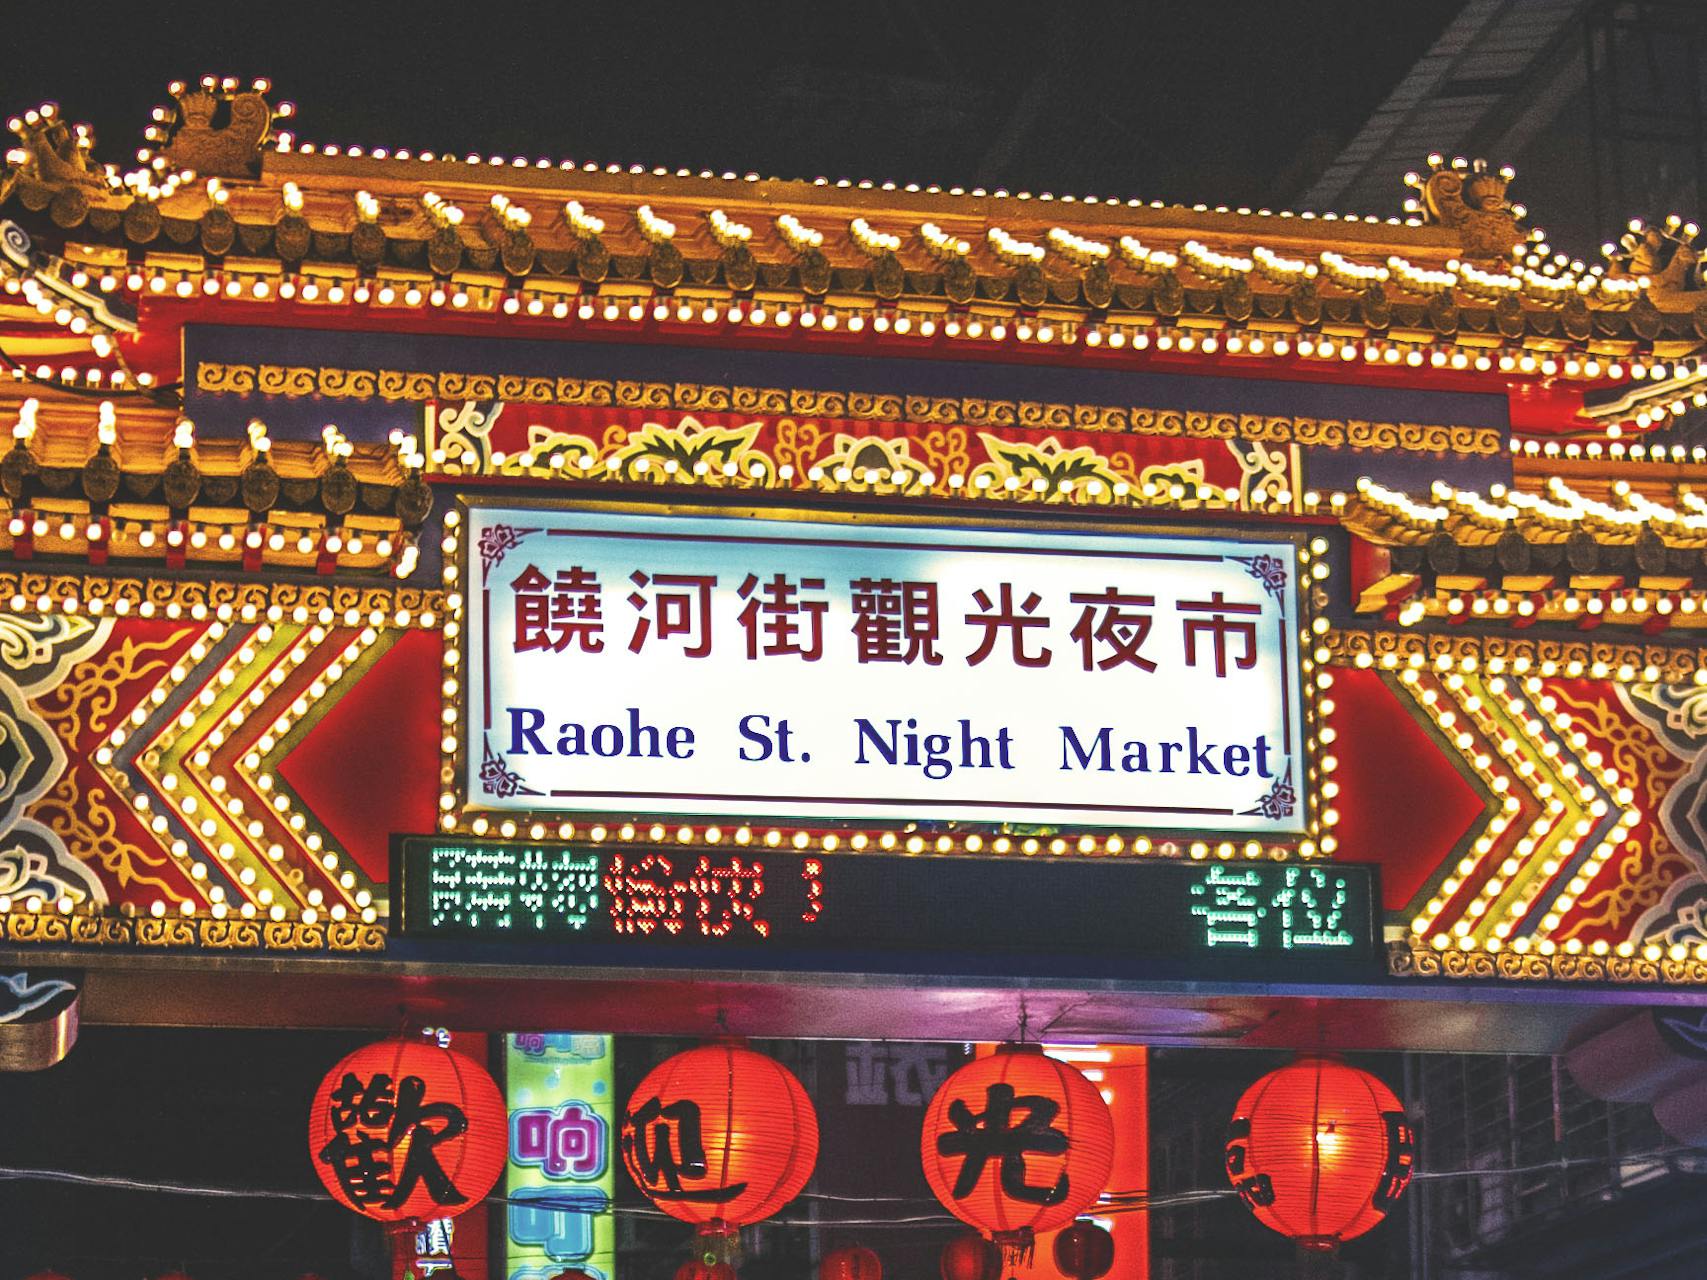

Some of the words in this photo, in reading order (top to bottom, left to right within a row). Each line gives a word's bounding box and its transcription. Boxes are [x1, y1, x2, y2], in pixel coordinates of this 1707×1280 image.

[512, 564, 1262, 678] 饒河街觀光夜市
[506, 706, 696, 761] Raohe
[738, 713, 811, 763] St.
[854, 717, 1014, 780] Night
[1060, 725, 1272, 778] Market
[318, 1073, 468, 1210] 歡
[620, 1097, 748, 1202] 迎
[936, 1082, 1070, 1206] 光
